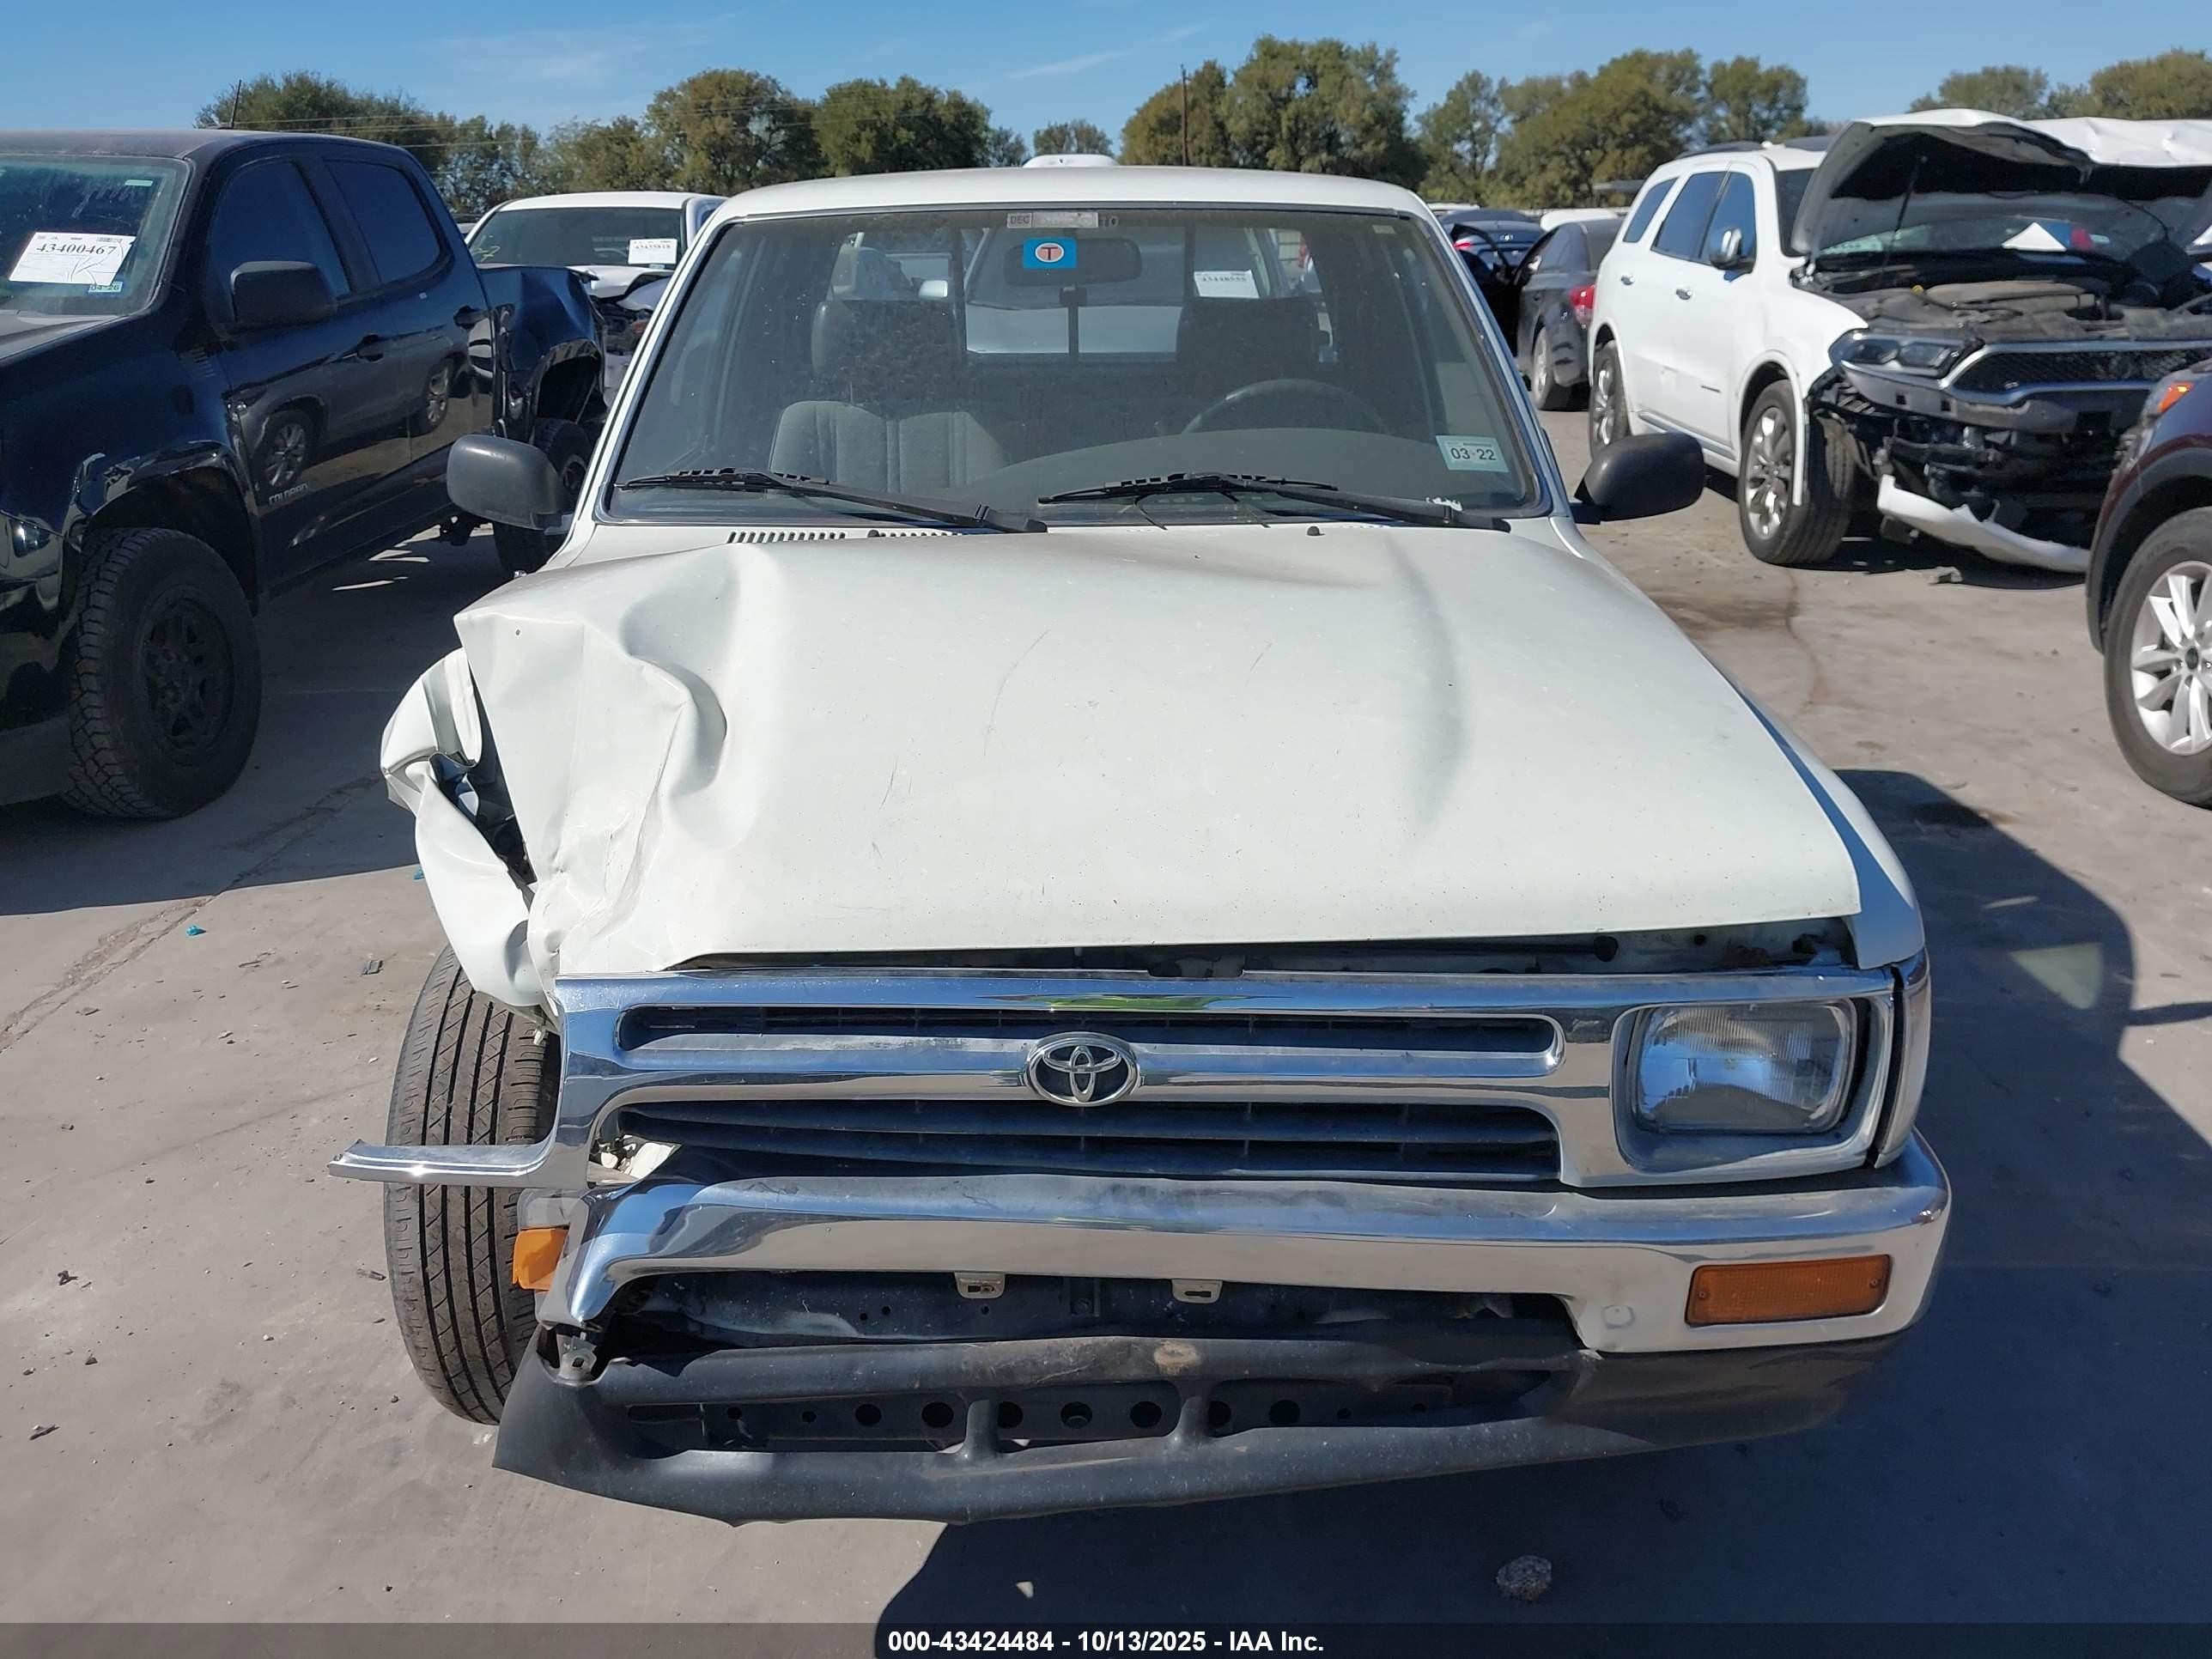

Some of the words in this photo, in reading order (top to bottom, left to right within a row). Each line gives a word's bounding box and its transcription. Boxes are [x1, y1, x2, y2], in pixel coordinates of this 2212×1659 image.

[1010, 215, 1030, 225] DEC
[36, 242, 118, 255] 43400467
[1040, 246, 1059, 261] T
